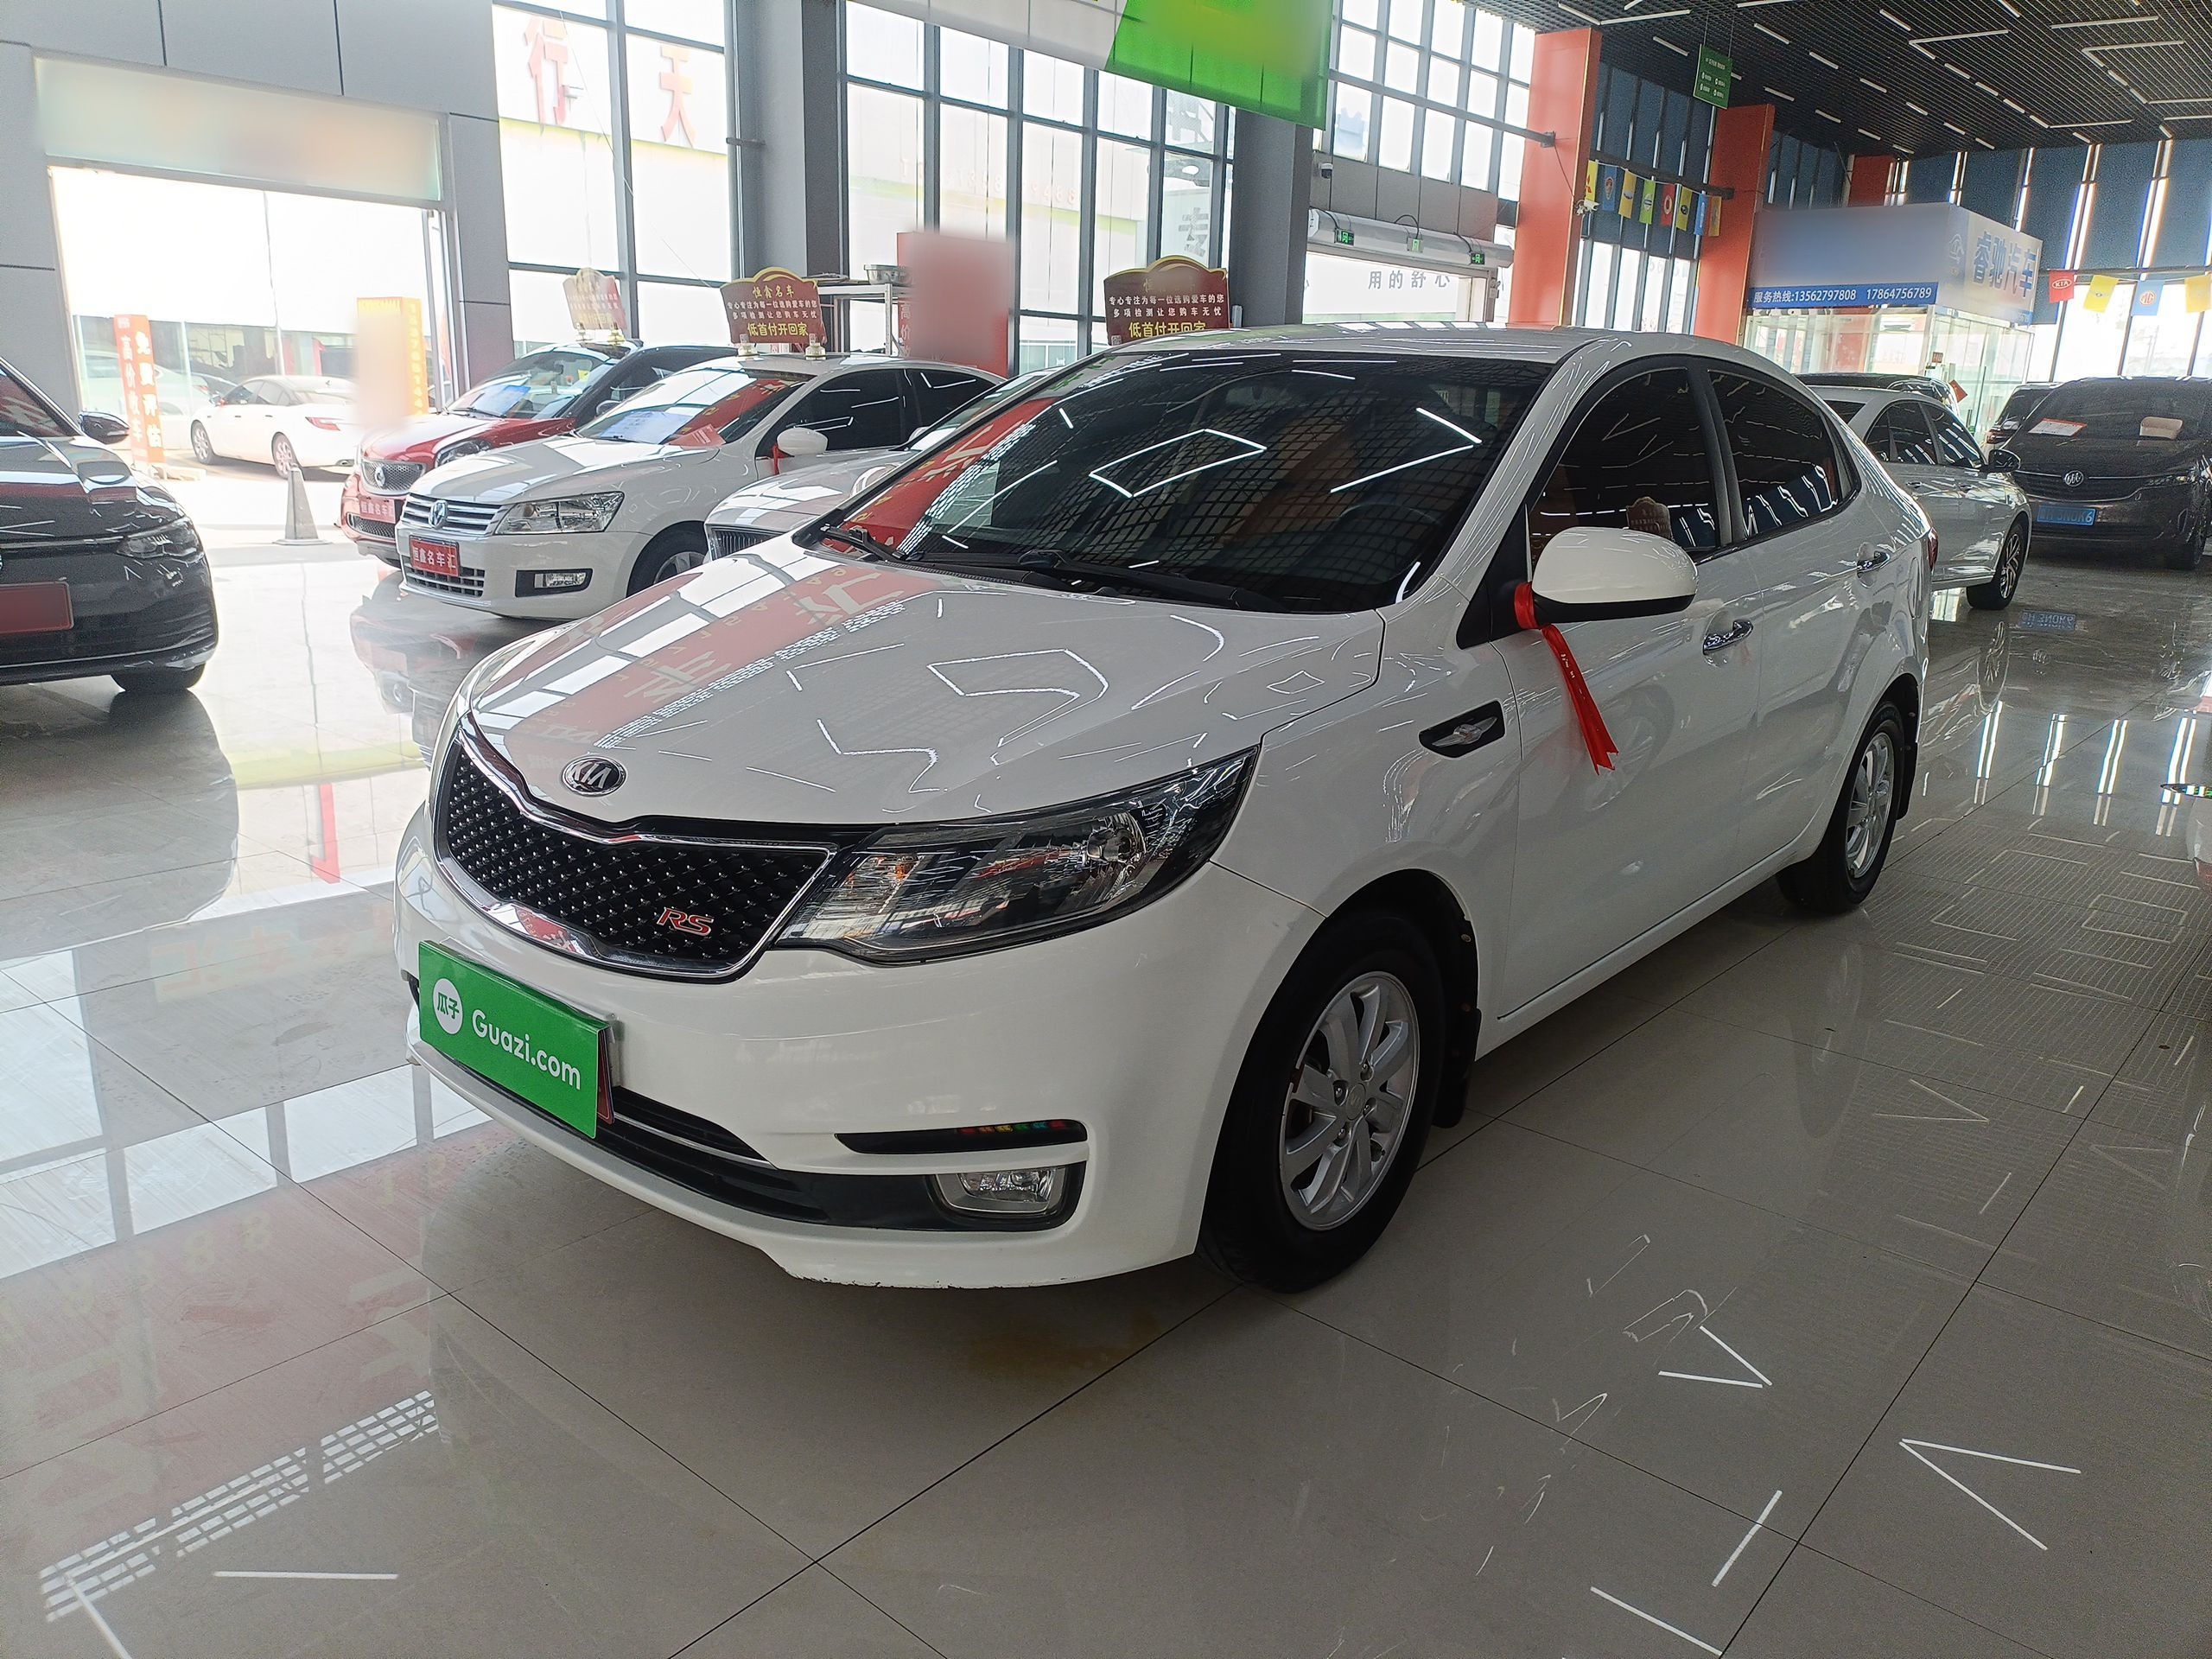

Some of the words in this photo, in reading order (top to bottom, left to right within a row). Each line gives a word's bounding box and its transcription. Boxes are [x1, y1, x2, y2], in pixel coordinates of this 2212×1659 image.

[1974, 231, 2037, 297] 睿驰汽车
[1369, 270, 1450, 289] 用的舒心
[1109, 294, 1224, 305] 专心专注为每一位选购爱车的您
[1866, 287, 1932, 300] 17864756789
[1113, 307, 1222, 317] 多项检测让您购车无忧
[747, 322, 809, 336] 低首付开回家
[657, 907, 715, 937] RS
[437, 991, 460, 1020] 瓜子
[472, 1009, 581, 1090] Guazi.com
